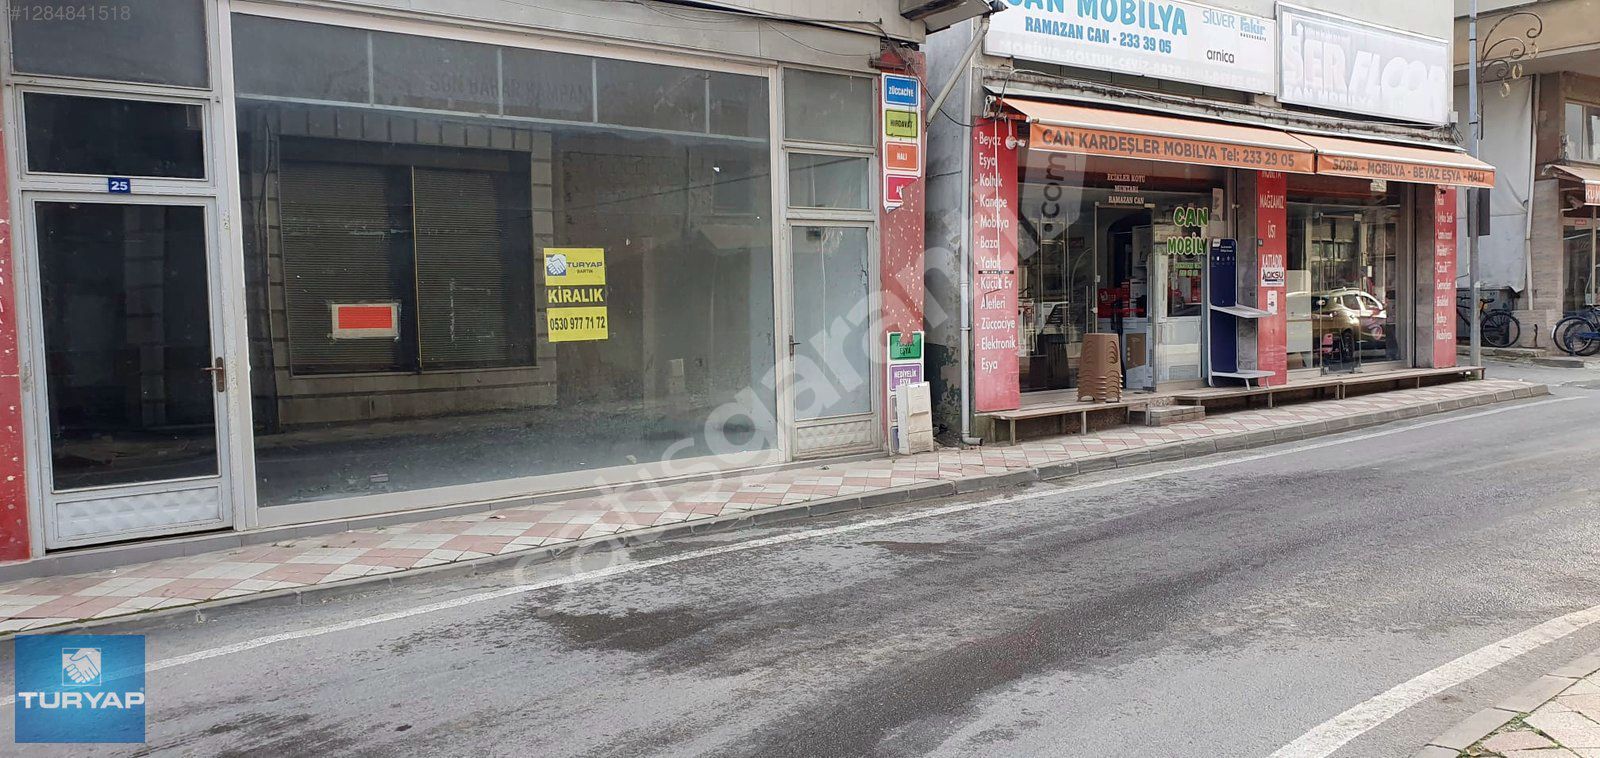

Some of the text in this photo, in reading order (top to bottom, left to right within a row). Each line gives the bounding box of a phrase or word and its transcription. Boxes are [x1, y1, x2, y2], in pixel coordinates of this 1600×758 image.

[1025, 16, 1084, 40] RAMAZAN
[1087, 26, 1110, 44] CAN
[1119, 32, 1140, 49] 233
[1143, 36, 1156, 53] 39
[1159, 38, 1172, 54] 05
[1206, 49, 1235, 64] arnica
[979, 131, 1001, 148] Beyaz
[1042, 128, 1295, 167] CAN KARDEŞLER MOBİLYA Tel: 233 29 05
[896, 152, 907, 161] HALI
[979, 152, 996, 169] Eşya
[1332, 159, 1359, 173] SOBA
[1367, 162, 1406, 177] MOBİLYA
[1413, 166, 1440, 180] BEYAZ
[1441, 168, 1461, 182] EŞYA
[1467, 171, 1485, 183] HALI
[111, 181, 128, 191] 25
[979, 173, 1003, 187] Koltuk
[979, 194, 1008, 210] Kanepe
[980, 215, 1009, 231] Mobilya
[1173, 206, 1208, 227] CAN
[980, 236, 998, 248] Baza
[1166, 231, 1207, 255] MOBİLY
[980, 256, 1001, 269] Yatak
[1004, 278, 1013, 290] Ev
[547, 286, 604, 303] KİRALIK
[980, 296, 1006, 309] Aletleri
[550, 316, 606, 330] 0530 977 71 72
[981, 317, 1015, 332] Züccaciye
[981, 335, 1016, 350] Elektronik
[981, 358, 998, 373] Eşya
